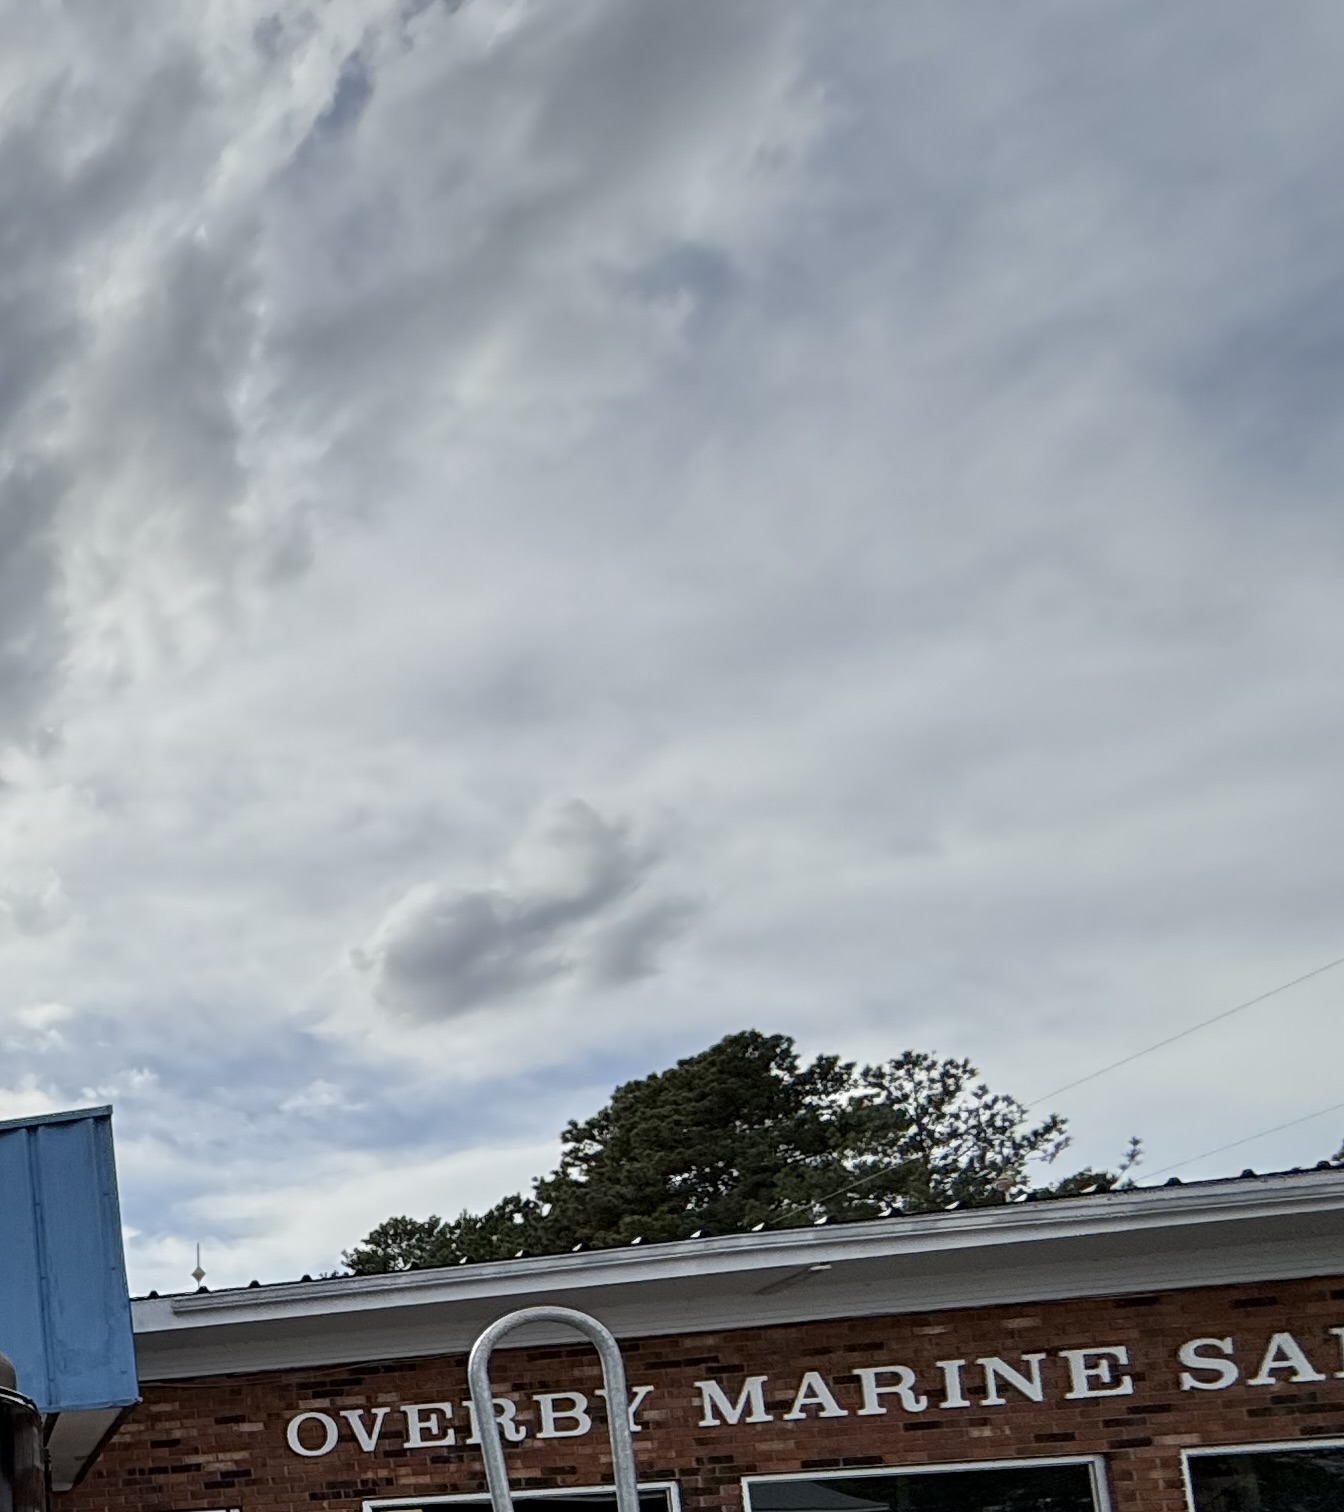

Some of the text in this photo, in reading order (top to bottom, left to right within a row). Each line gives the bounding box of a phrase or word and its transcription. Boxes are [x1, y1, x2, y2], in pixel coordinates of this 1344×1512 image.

[286, 1326, 1344, 1457] OVERBY MARINE SA
